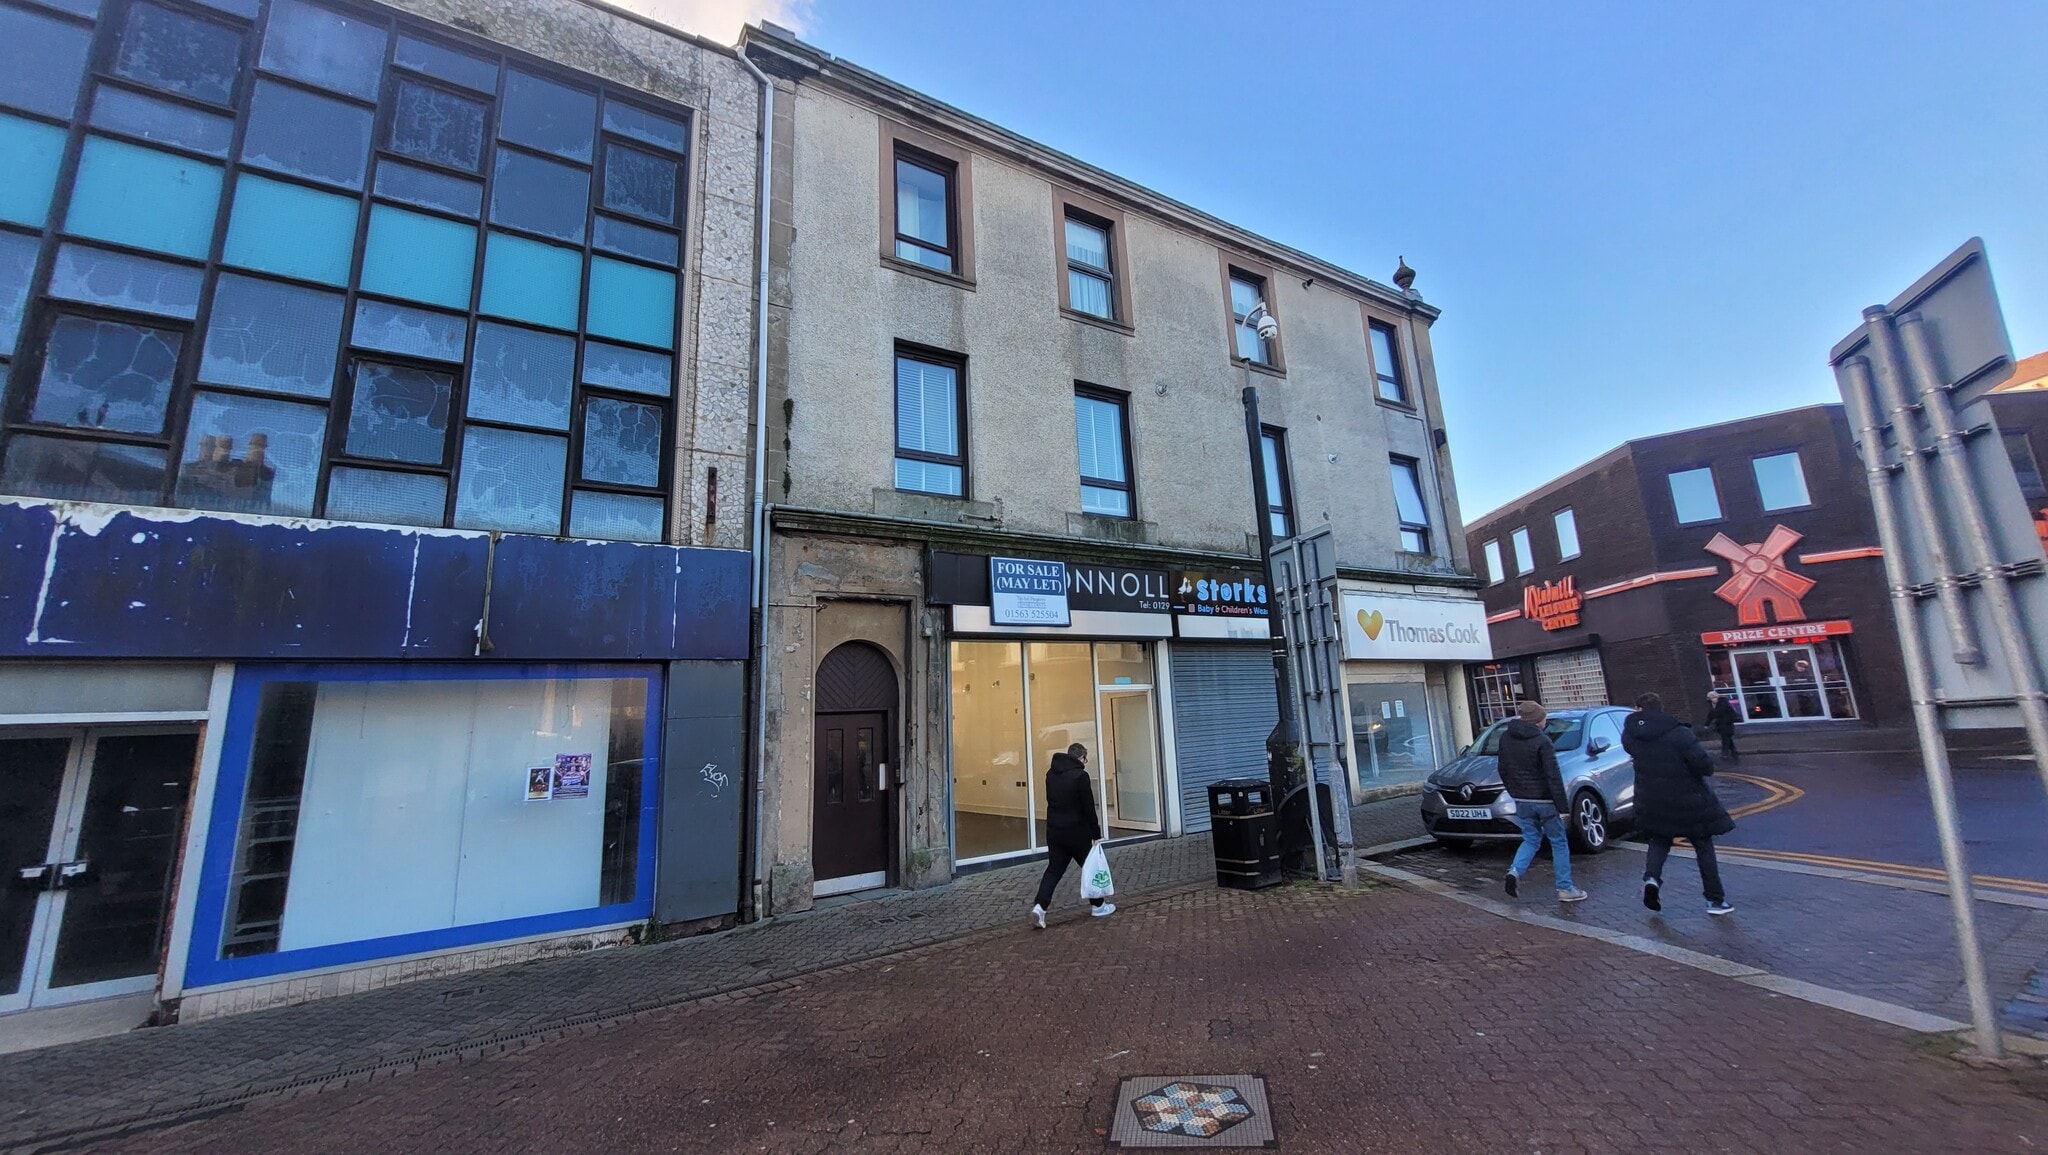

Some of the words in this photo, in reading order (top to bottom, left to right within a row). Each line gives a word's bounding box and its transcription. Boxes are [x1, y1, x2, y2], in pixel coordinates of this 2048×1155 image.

[997, 562, 1025, 575] FOR
[1027, 564, 1060, 577] SALE
[996, 576, 1031, 591] (MAY
[1033, 578, 1062, 593] LET)
[1066, 568, 1170, 598] NNOLL
[1139, 600, 1152, 609] Tel:
[1152, 601, 1170, 610] 0129
[1197, 603, 1214, 614] Baby
[1215, 604, 1220, 613] &
[1220, 605, 1253, 614] Children's
[1004, 608, 1029, 619] 01563
[1031, 609, 1059, 619] 525504
[1384, 619, 1446, 643] Thomas
[1445, 622, 1481, 644] Cook
[1722, 629, 1765, 641] PRIZE
[1767, 625, 1826, 637] CENTRE
